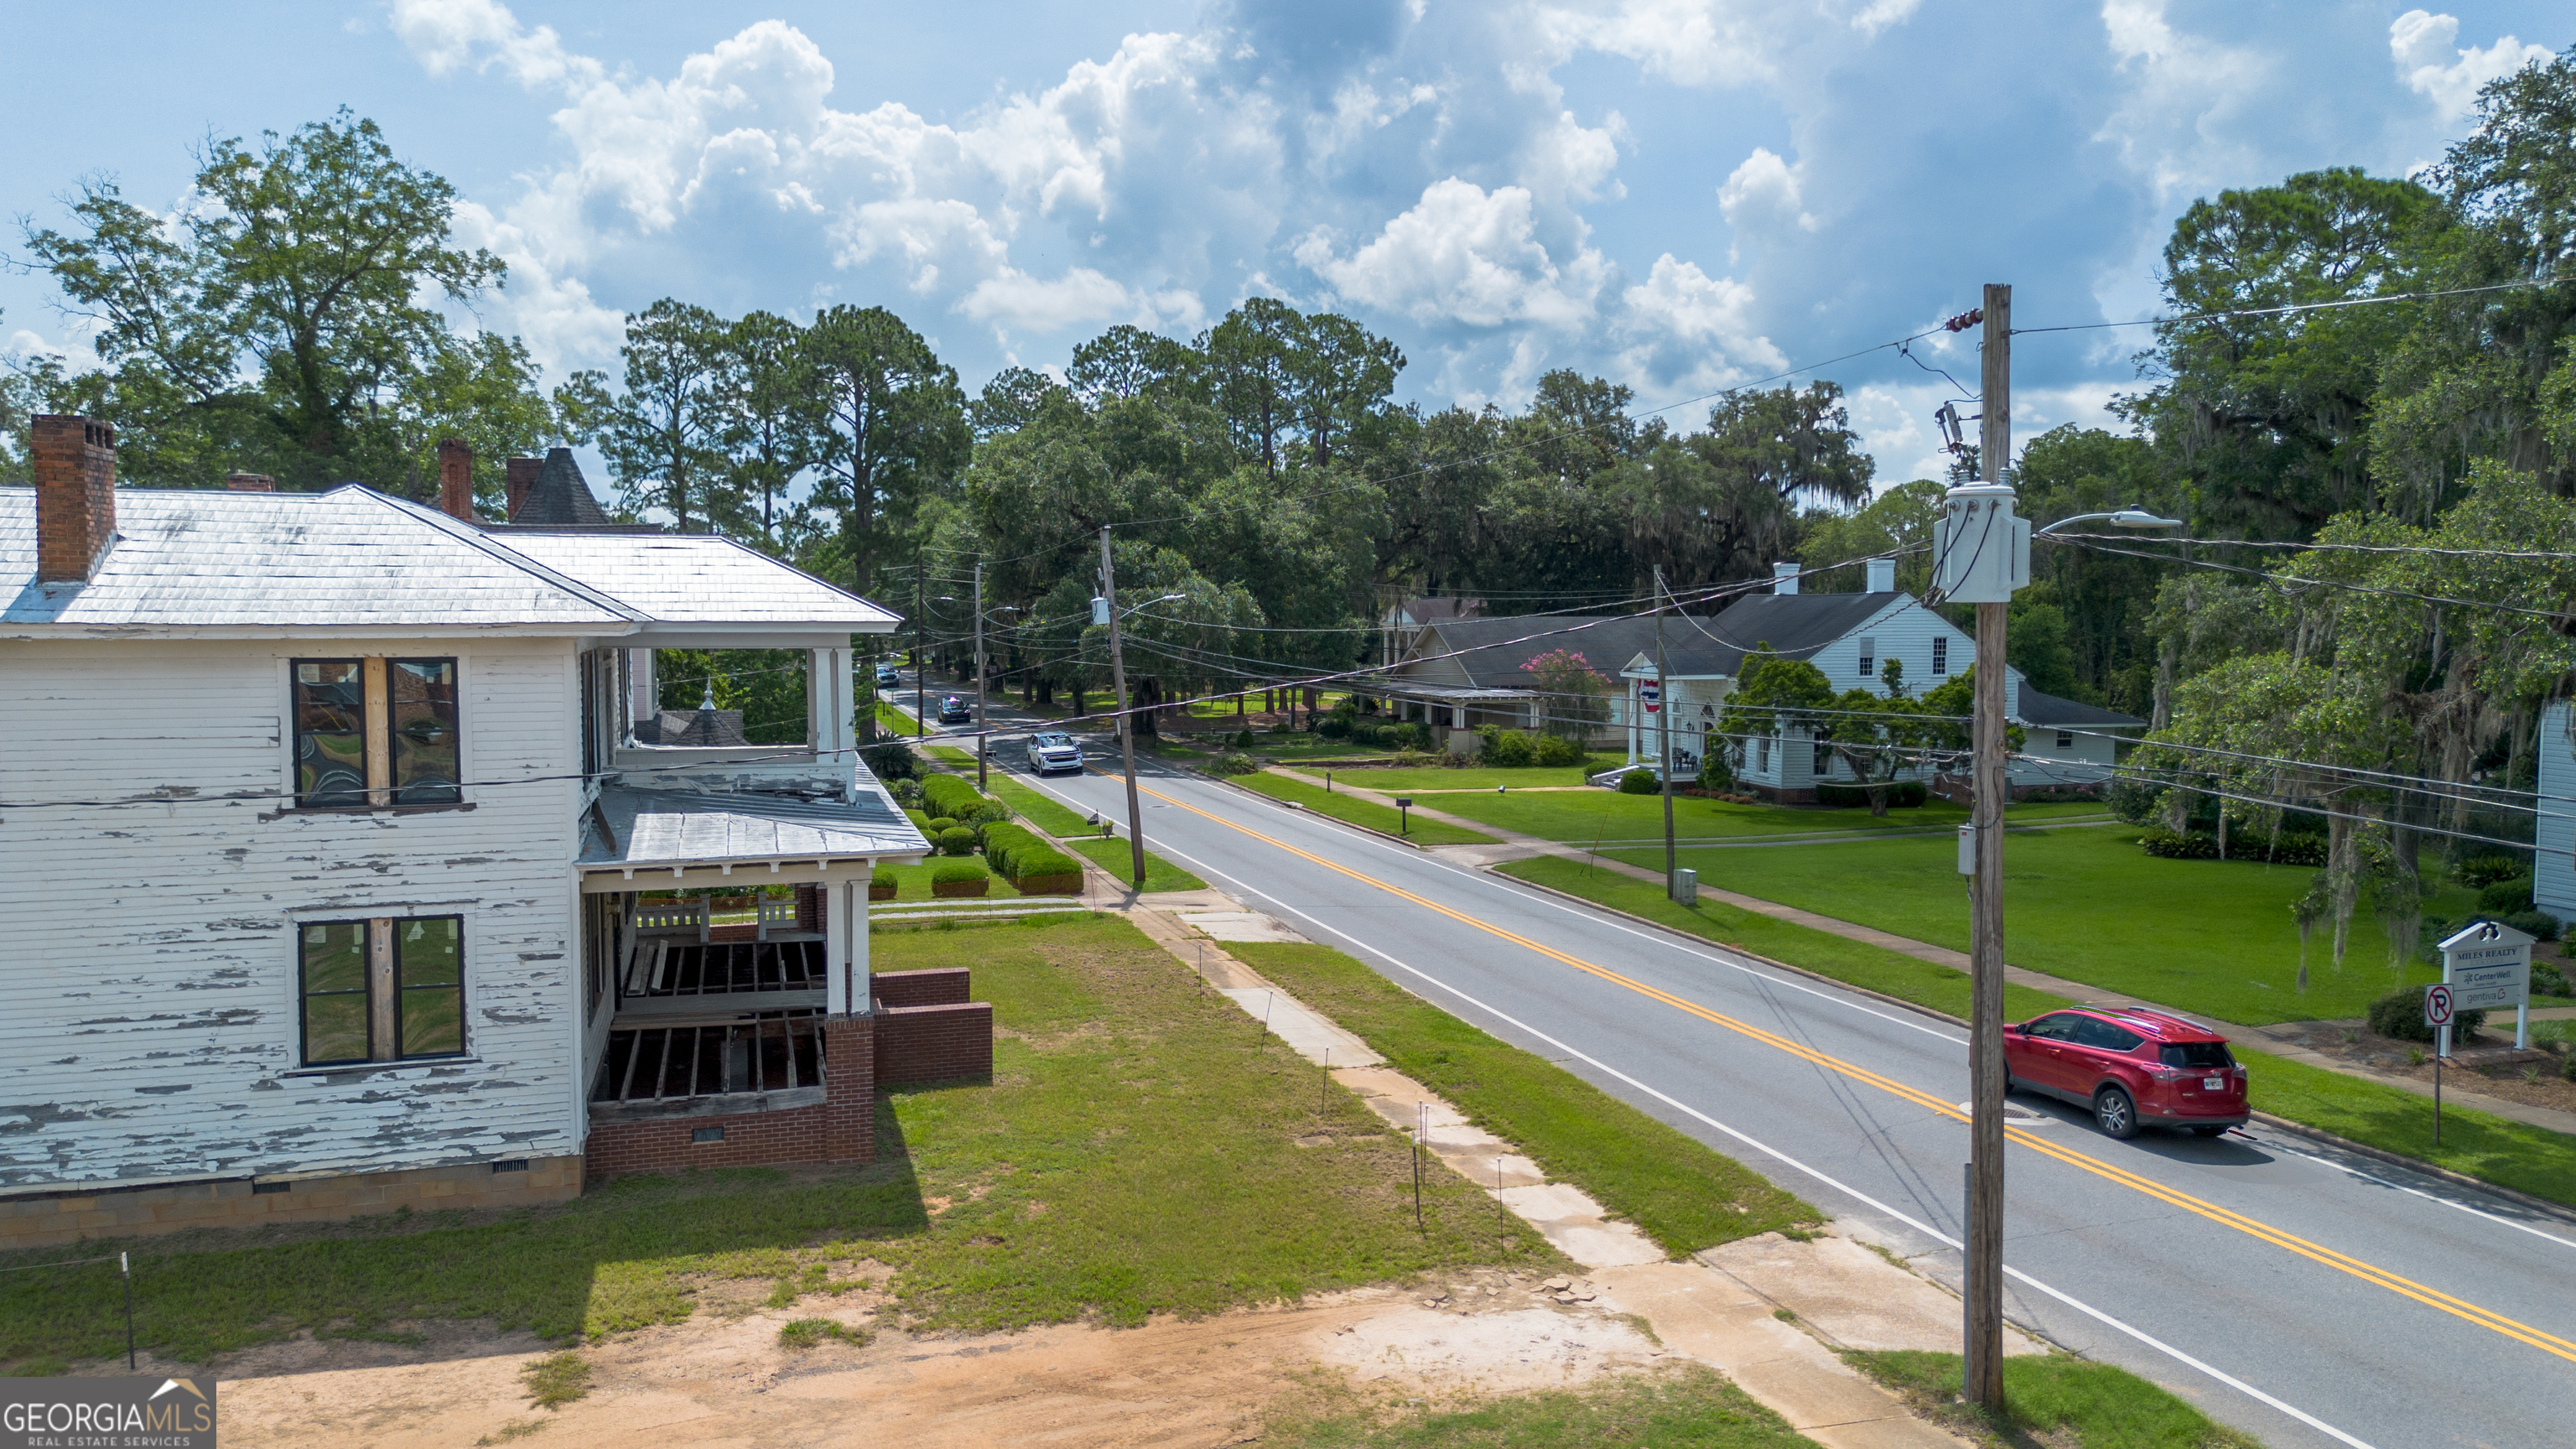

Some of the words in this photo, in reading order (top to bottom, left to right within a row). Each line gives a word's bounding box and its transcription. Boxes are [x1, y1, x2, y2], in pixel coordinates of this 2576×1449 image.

[2458, 951, 2483, 960] MILES
[2485, 948, 2516, 958] REALTY
[2474, 971, 2511, 981] CenterWell
[2467, 992, 2496, 1004] gentiva
[2434, 995, 2447, 1016] P
